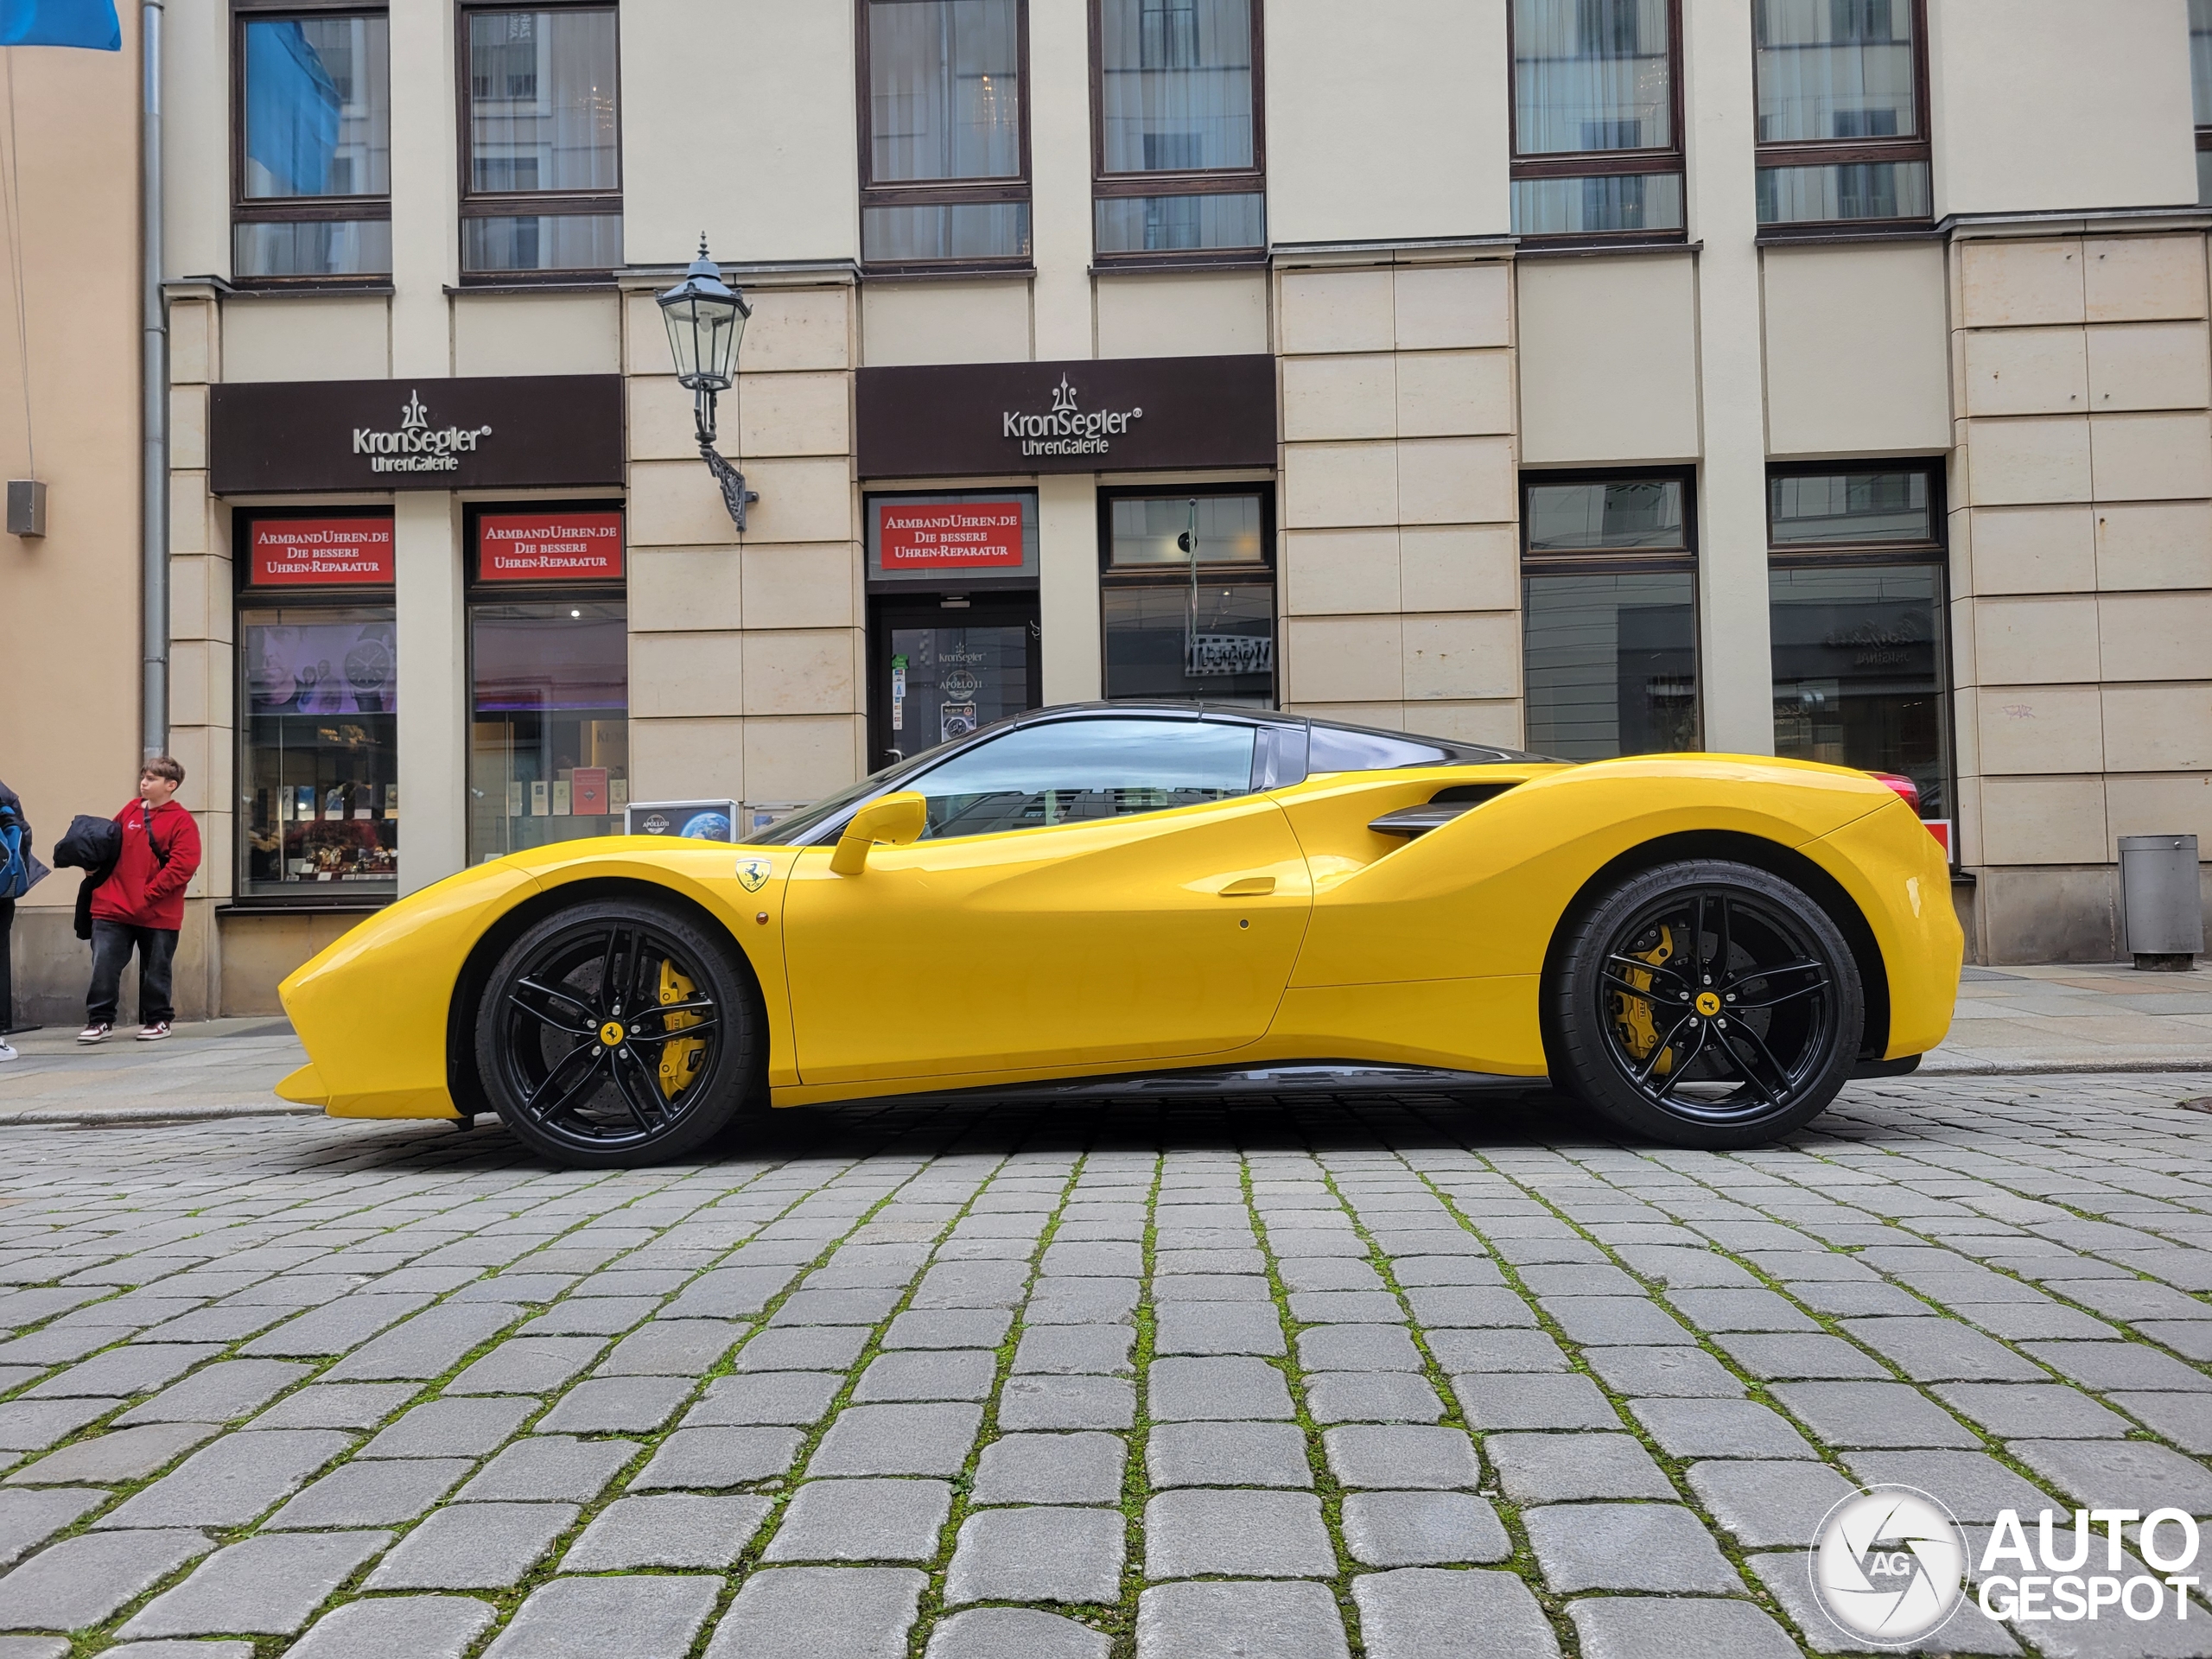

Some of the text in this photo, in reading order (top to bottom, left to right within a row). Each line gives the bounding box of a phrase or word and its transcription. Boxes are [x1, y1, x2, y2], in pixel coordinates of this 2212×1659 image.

[1022, 438, 1109, 456] UhrenGalerie
[372, 455, 459, 473] UhrenGalerie
[914, 531, 988, 543] DIE BESSERE
[287, 547, 359, 559] DIE BESSERE
[514, 542, 588, 554] DIE BESSERE
[939, 681, 974, 690] APOLLO
[1608, 874, 1669, 920] MICHELIN
